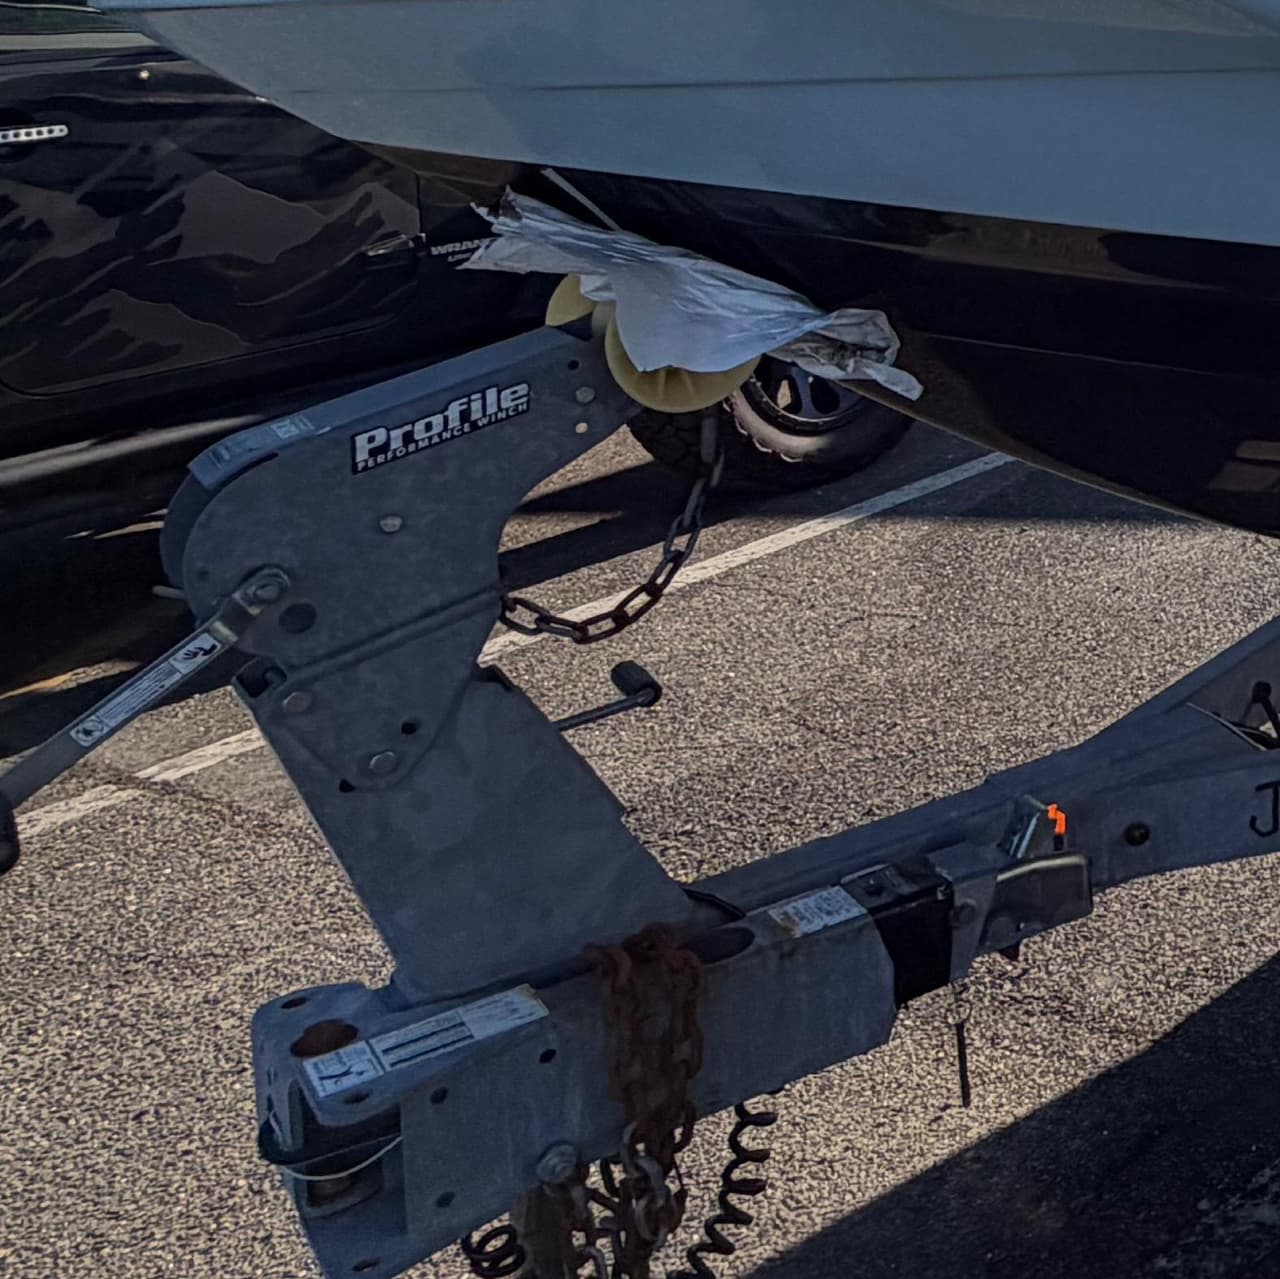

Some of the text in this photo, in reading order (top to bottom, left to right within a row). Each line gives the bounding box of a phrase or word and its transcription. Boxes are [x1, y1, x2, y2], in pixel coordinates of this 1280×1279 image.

[355, 384, 529, 464] Profile
[357, 425, 471, 472] PERFORMANCE
[476, 402, 528, 428] WINCH
